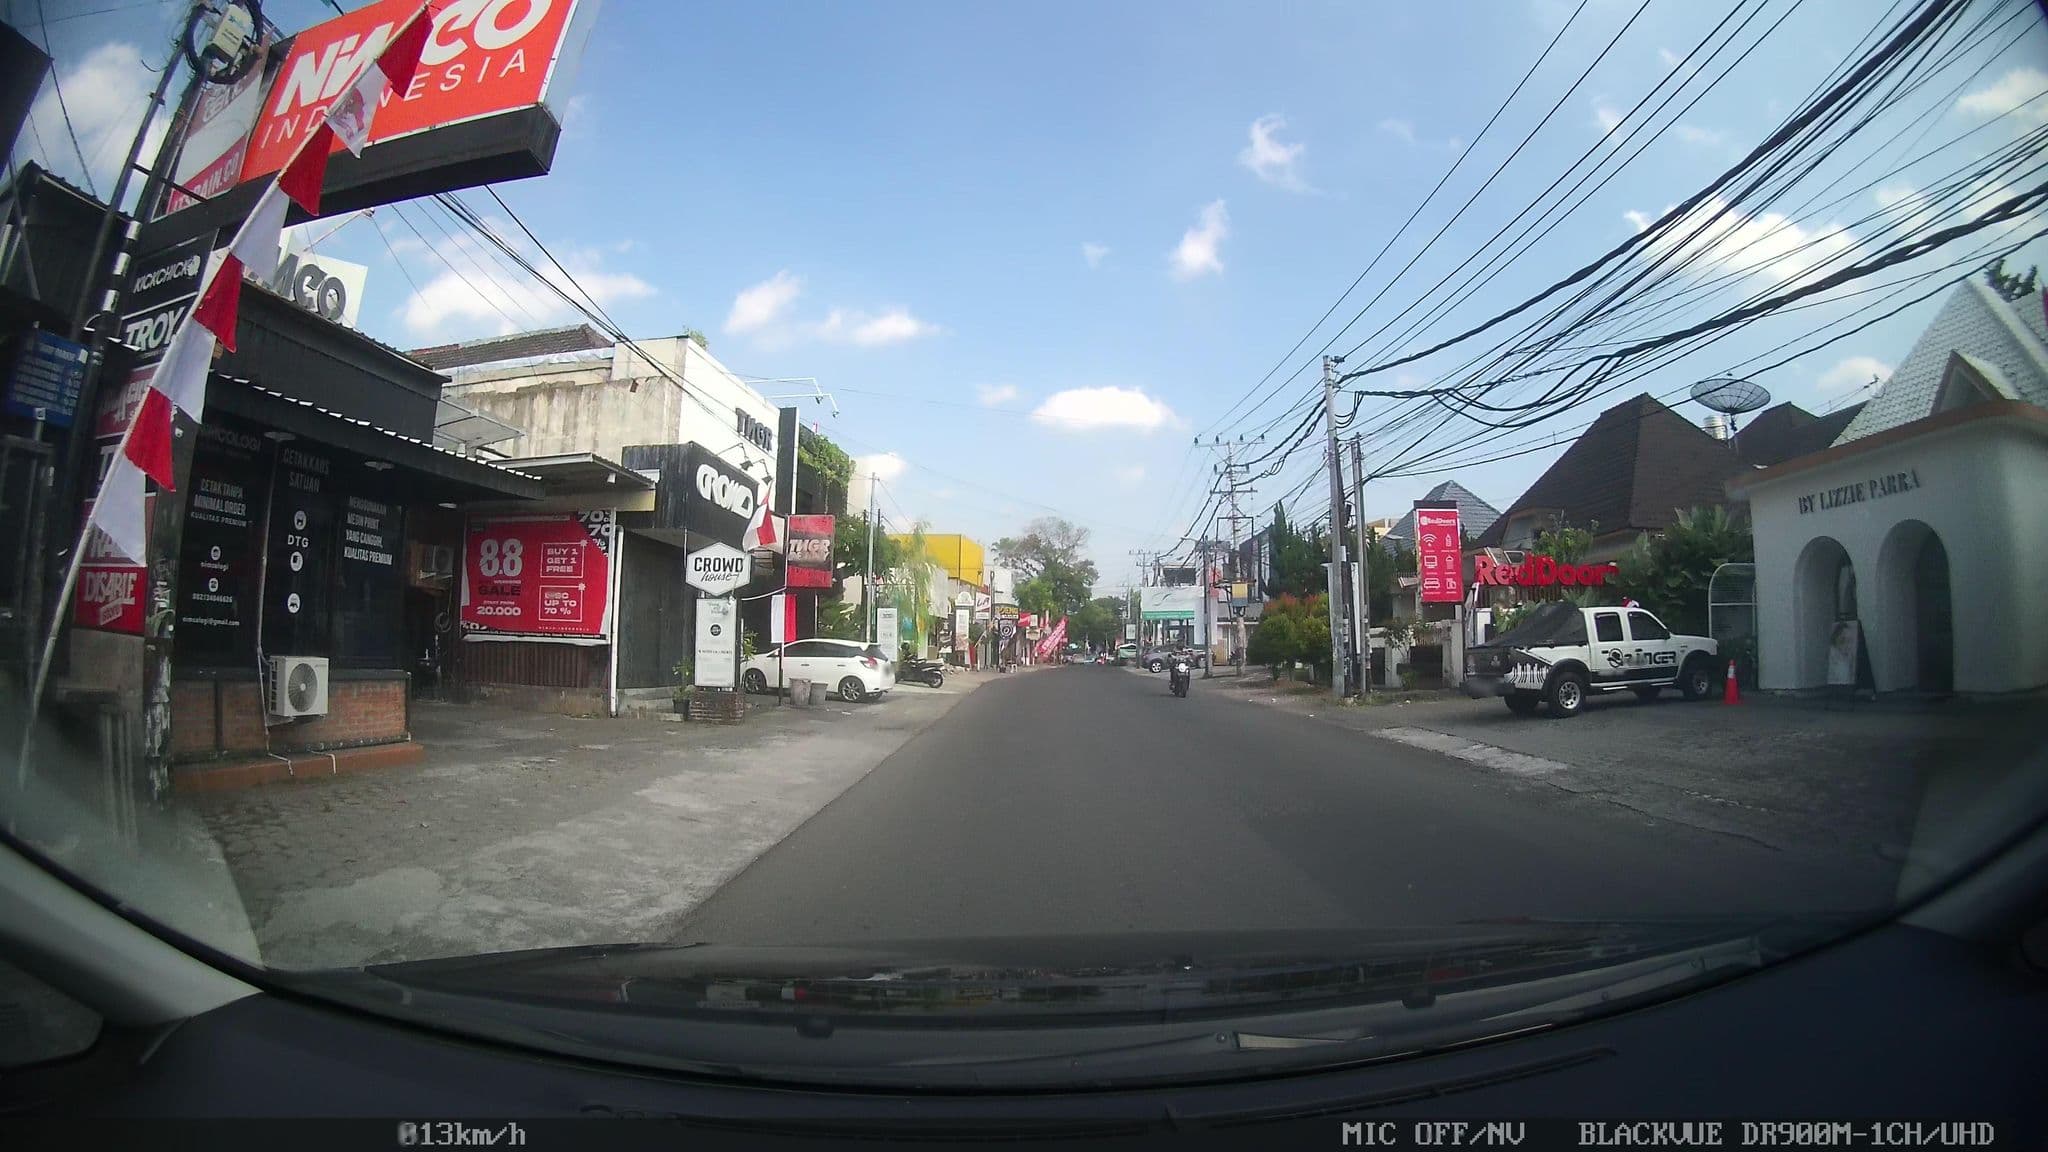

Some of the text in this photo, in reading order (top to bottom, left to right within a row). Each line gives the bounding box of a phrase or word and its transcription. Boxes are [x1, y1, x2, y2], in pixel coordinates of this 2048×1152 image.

[126, 306, 186, 352] TROY
[1799, 495, 1815, 514] BY
[1820, 482, 1865, 510] LIZZIE
[287, 534, 310, 548] DTG
[343, 546, 393, 566] KUALITAS PREMIUM
[545, 565, 574, 573] FREE
[694, 557, 744, 573] CROWD
[701, 570, 739, 583] house
[478, 584, 521, 597] SALE
[544, 600, 561, 608] UP
[476, 606, 522, 616] 20.000
